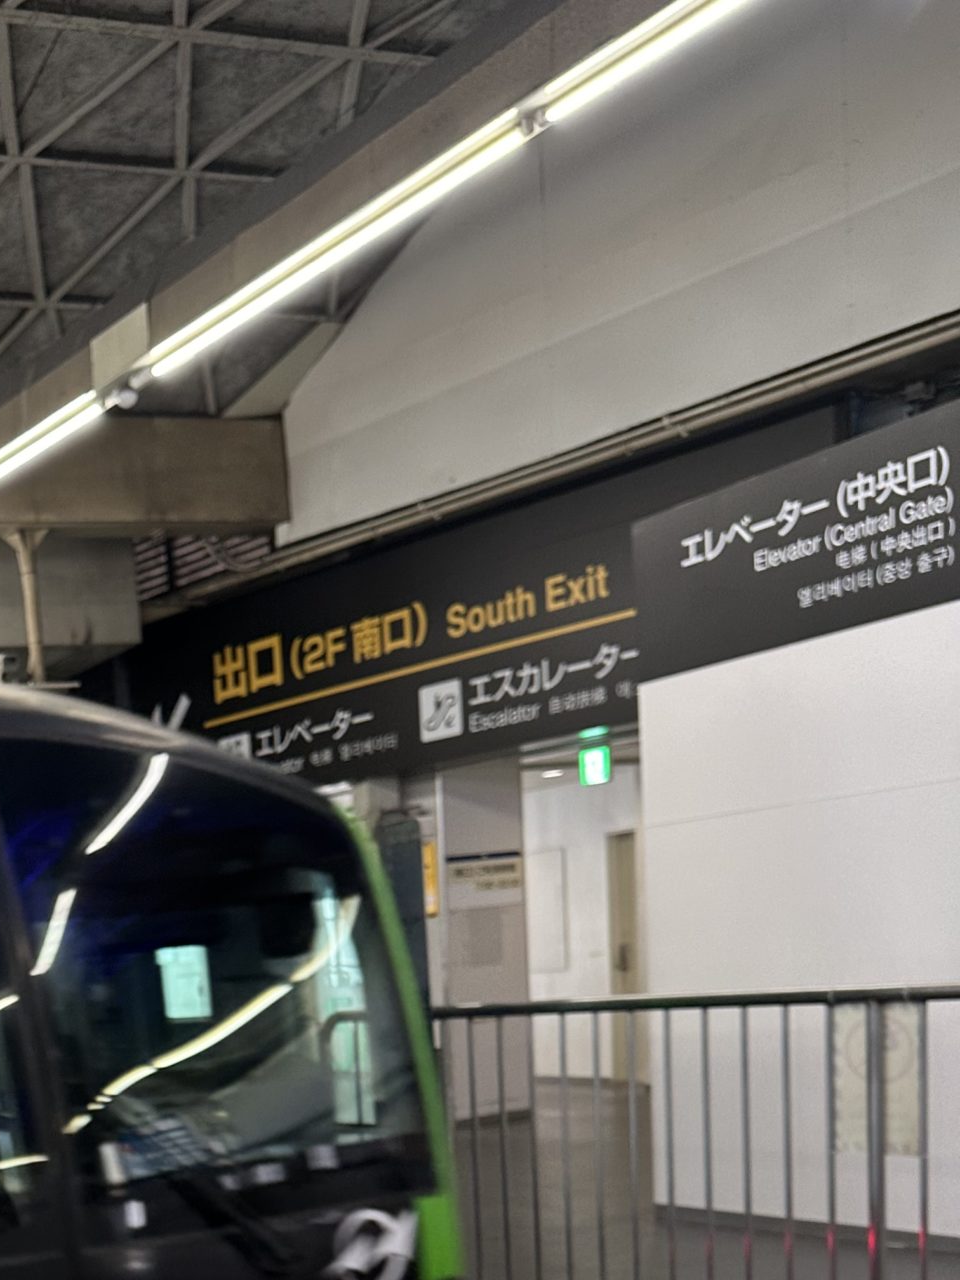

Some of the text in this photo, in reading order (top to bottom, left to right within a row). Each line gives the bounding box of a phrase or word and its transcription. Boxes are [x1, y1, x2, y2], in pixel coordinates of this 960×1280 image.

[753, 486, 954, 572] Elevator (Central Gate)
[446, 563, 610, 639] South Exit
[467, 643, 640, 706] エスカレーター
[254, 708, 375, 757] エレベーター
[468, 703, 543, 734] Escalator
